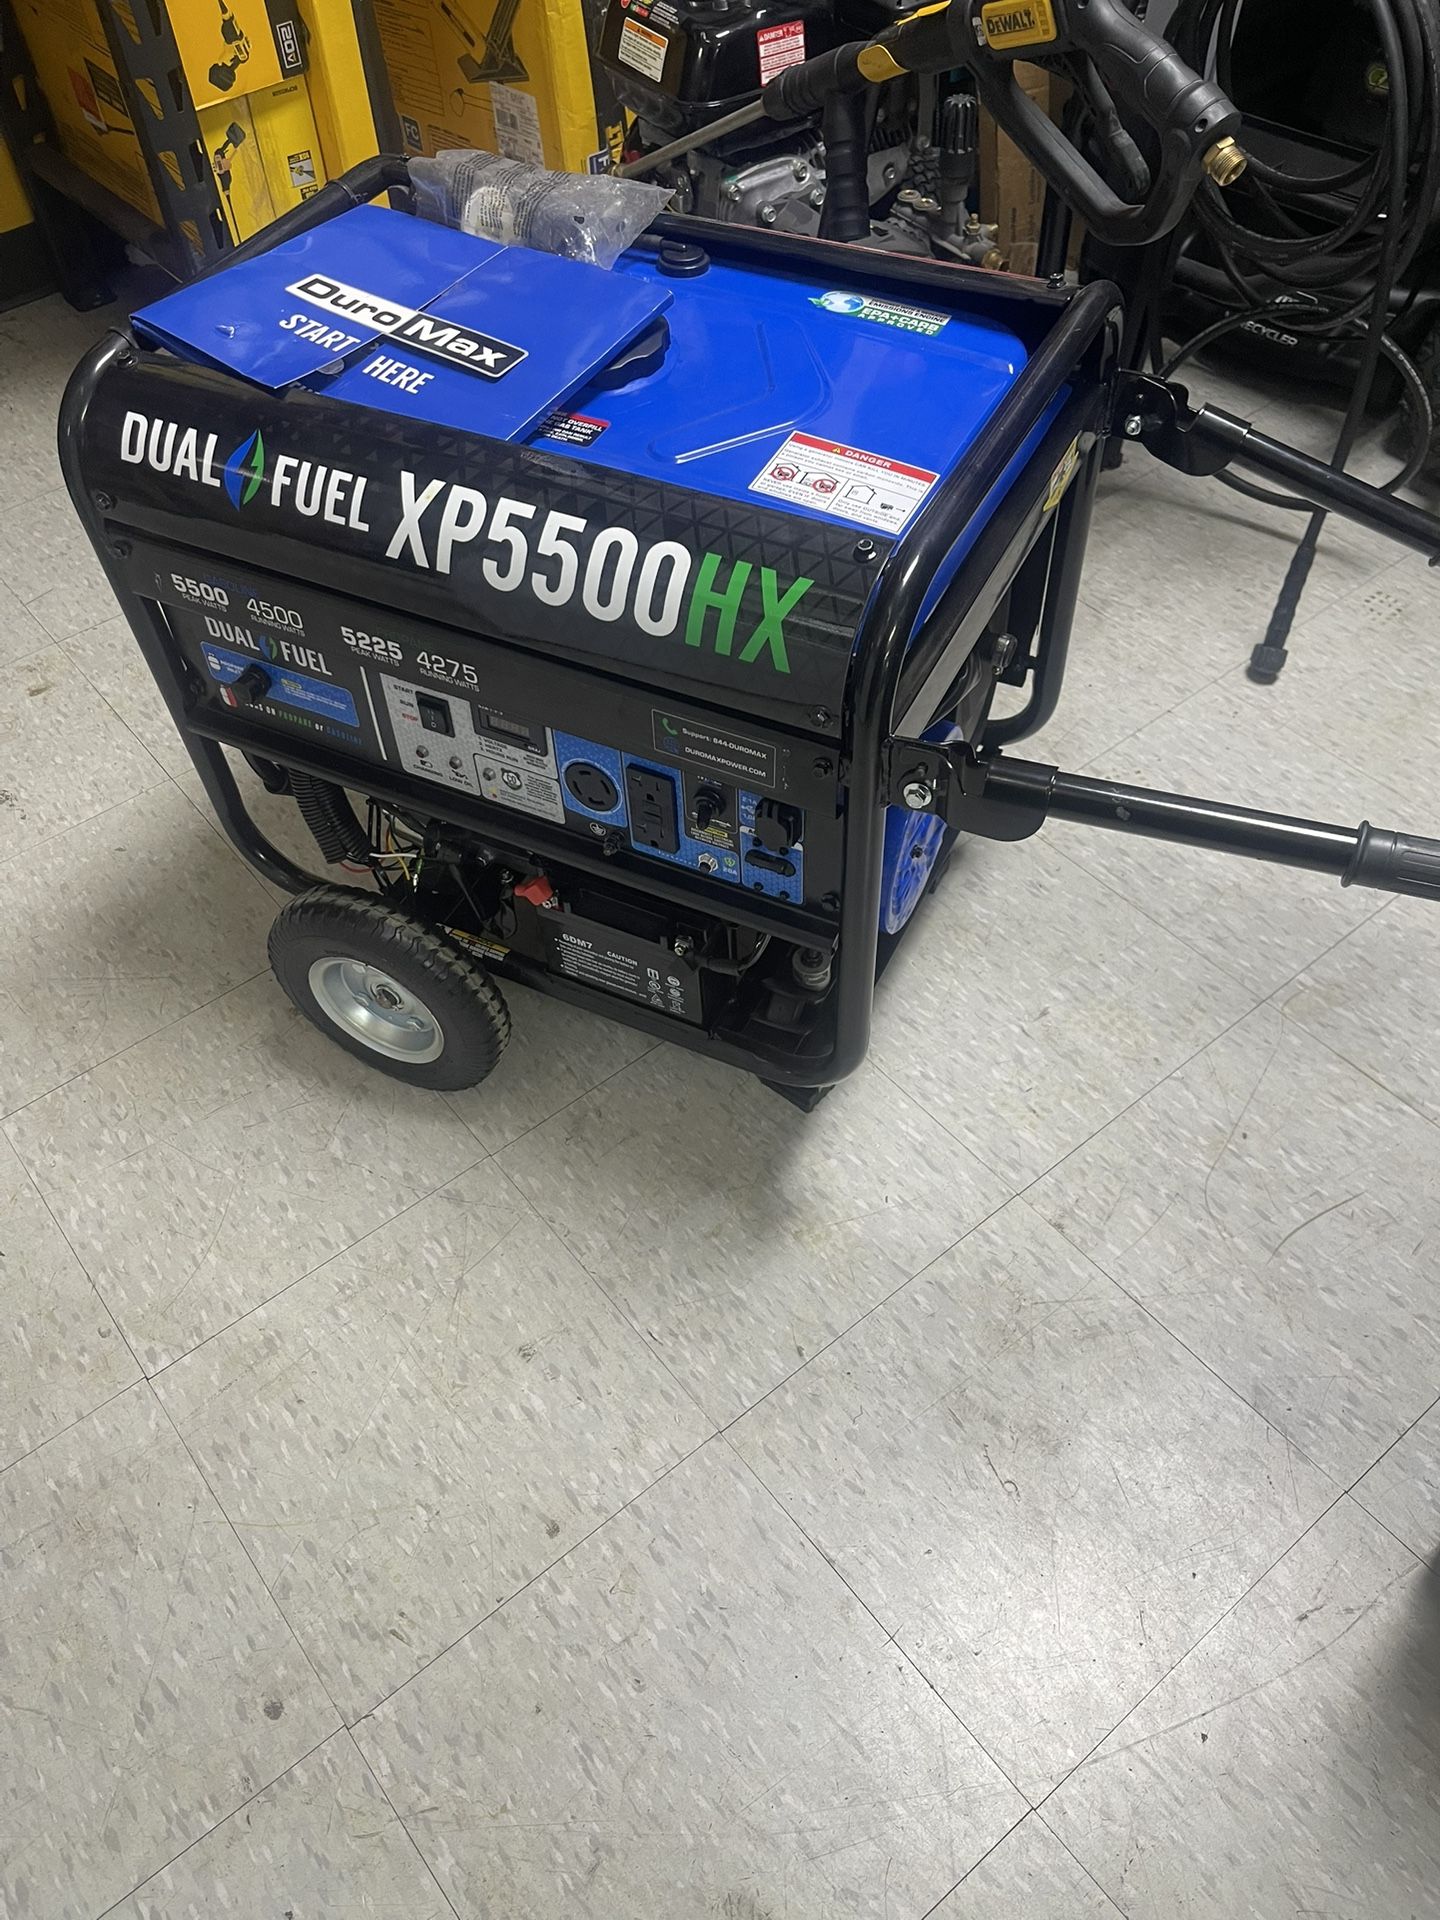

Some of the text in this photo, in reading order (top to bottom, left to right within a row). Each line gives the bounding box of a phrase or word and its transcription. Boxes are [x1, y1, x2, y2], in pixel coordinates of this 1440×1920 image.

[279, 314, 361, 351] START
[857, 313, 934, 335] APPROVED
[861, 307, 940, 331] EPA+CARB
[362, 355, 435, 394] HERE
[844, 449, 893, 469] DANGER
[120, 410, 815, 674] DUAL FUEL XP5500HX
[170, 573, 304, 629] 5500 4500
[182, 592, 306, 638] PEAK WATTS RUNNING WATTS
[204, 615, 333, 676] DUAL FUEL
[340, 625, 479, 685] 5225 4275
[351, 645, 481, 693] PEAK WATTS RUNNING WATTS
[402, 712, 419, 722] STOP
[684, 746, 767, 778] DUROMAXPOWER.COM
[562, 932, 593, 949] 6DM7
[606, 950, 638, 967] CAUTION
